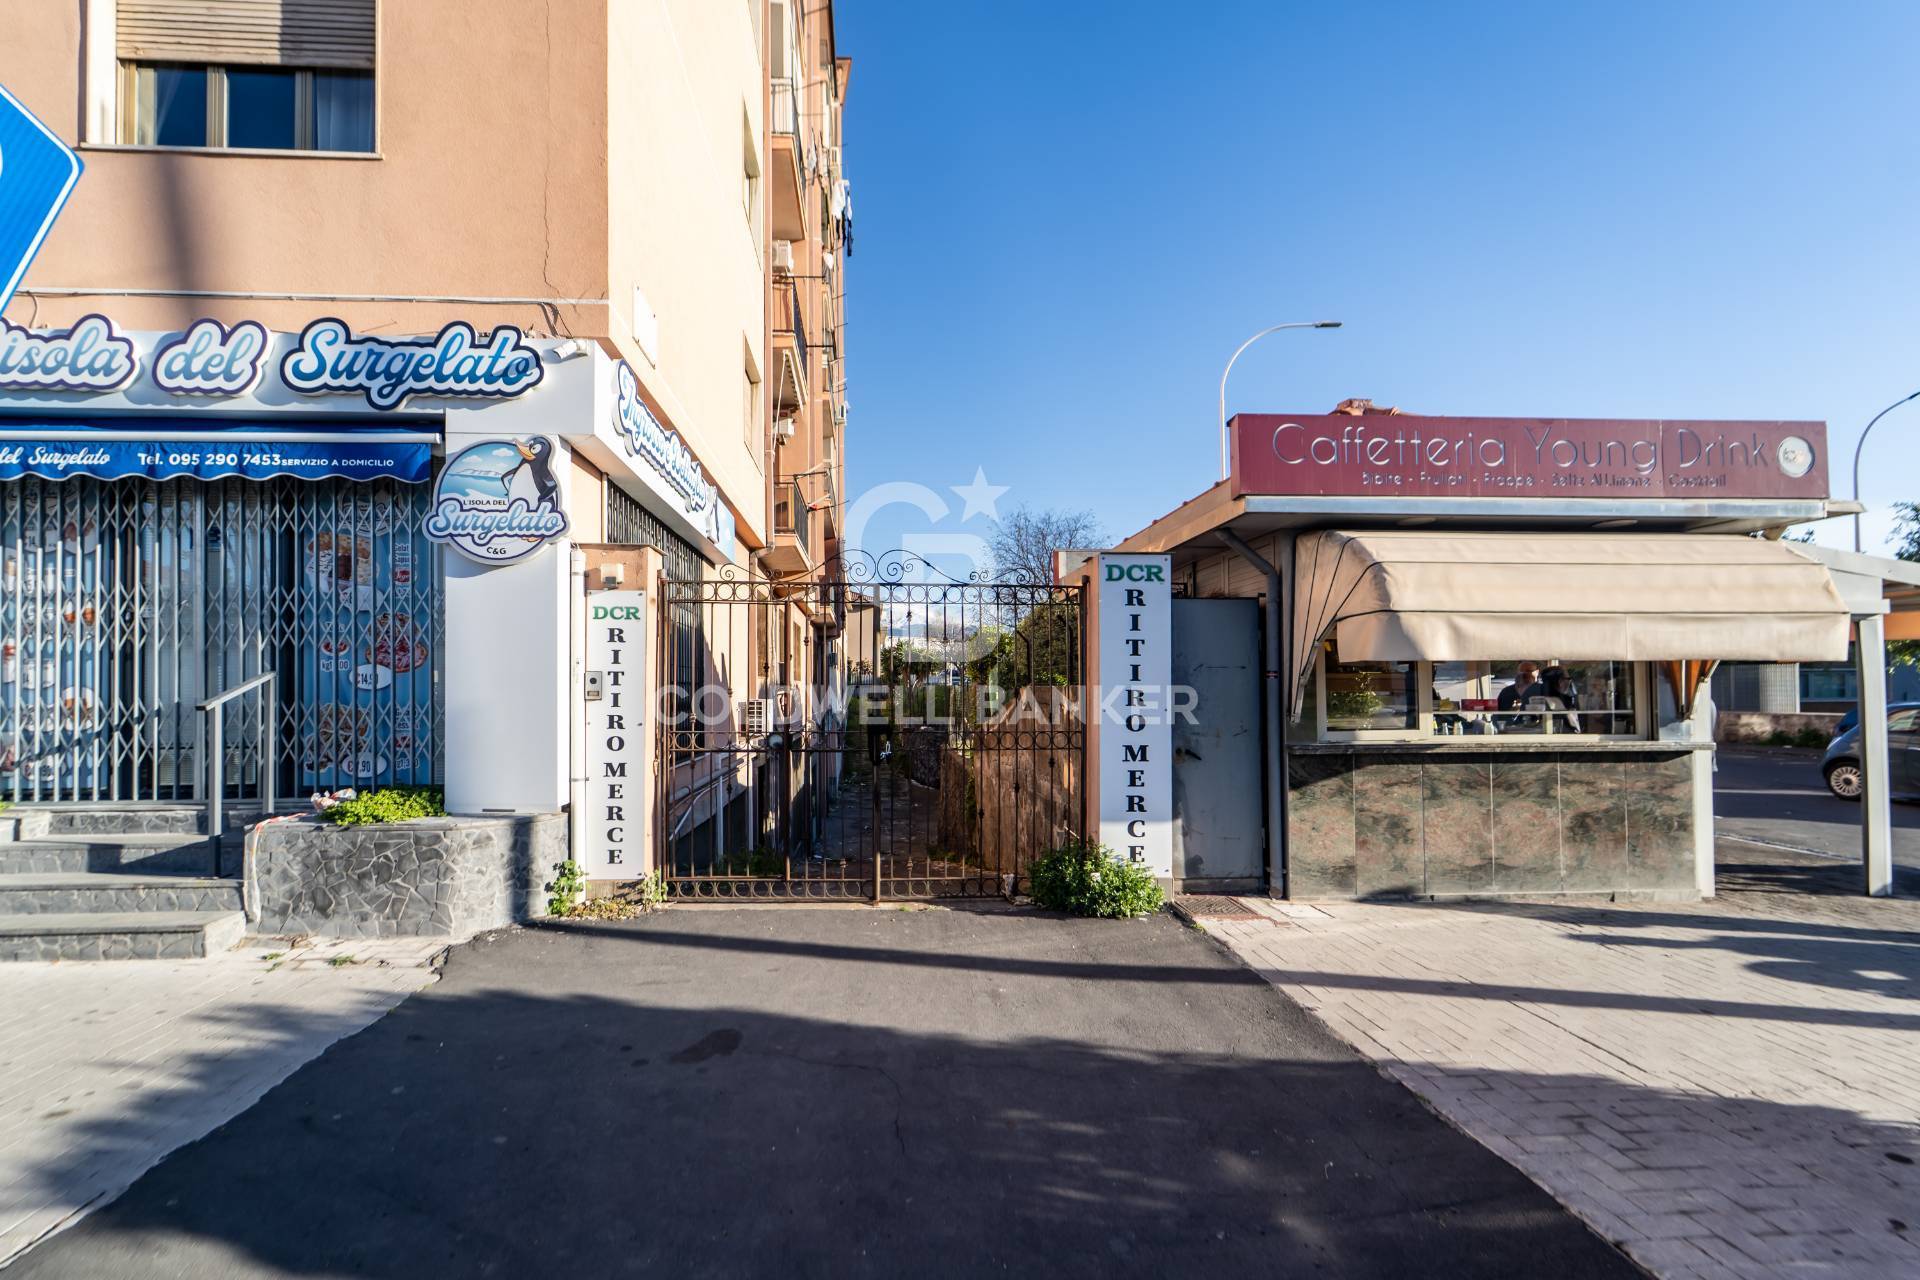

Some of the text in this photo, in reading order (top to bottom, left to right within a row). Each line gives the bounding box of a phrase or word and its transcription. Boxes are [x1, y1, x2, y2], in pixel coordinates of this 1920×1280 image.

[164, 331, 254, 382] del
[291, 328, 534, 399] Surgelato
[28, 446, 111, 470] Surgelato
[138, 453, 395, 467] Tel. 095 290 7453 SERVIZIO A DOMICILIO
[1272, 422, 1768, 476] Caffetteria Young Drink
[432, 503, 561, 541] Surgelato
[486, 546, 507, 555] C&G
[1105, 564, 1165, 583] DCR
[592, 606, 641, 621] DCR
[1121, 588, 1149, 863] RITIRO MERCE
[603, 627, 627, 865] RITIRO MERCE
